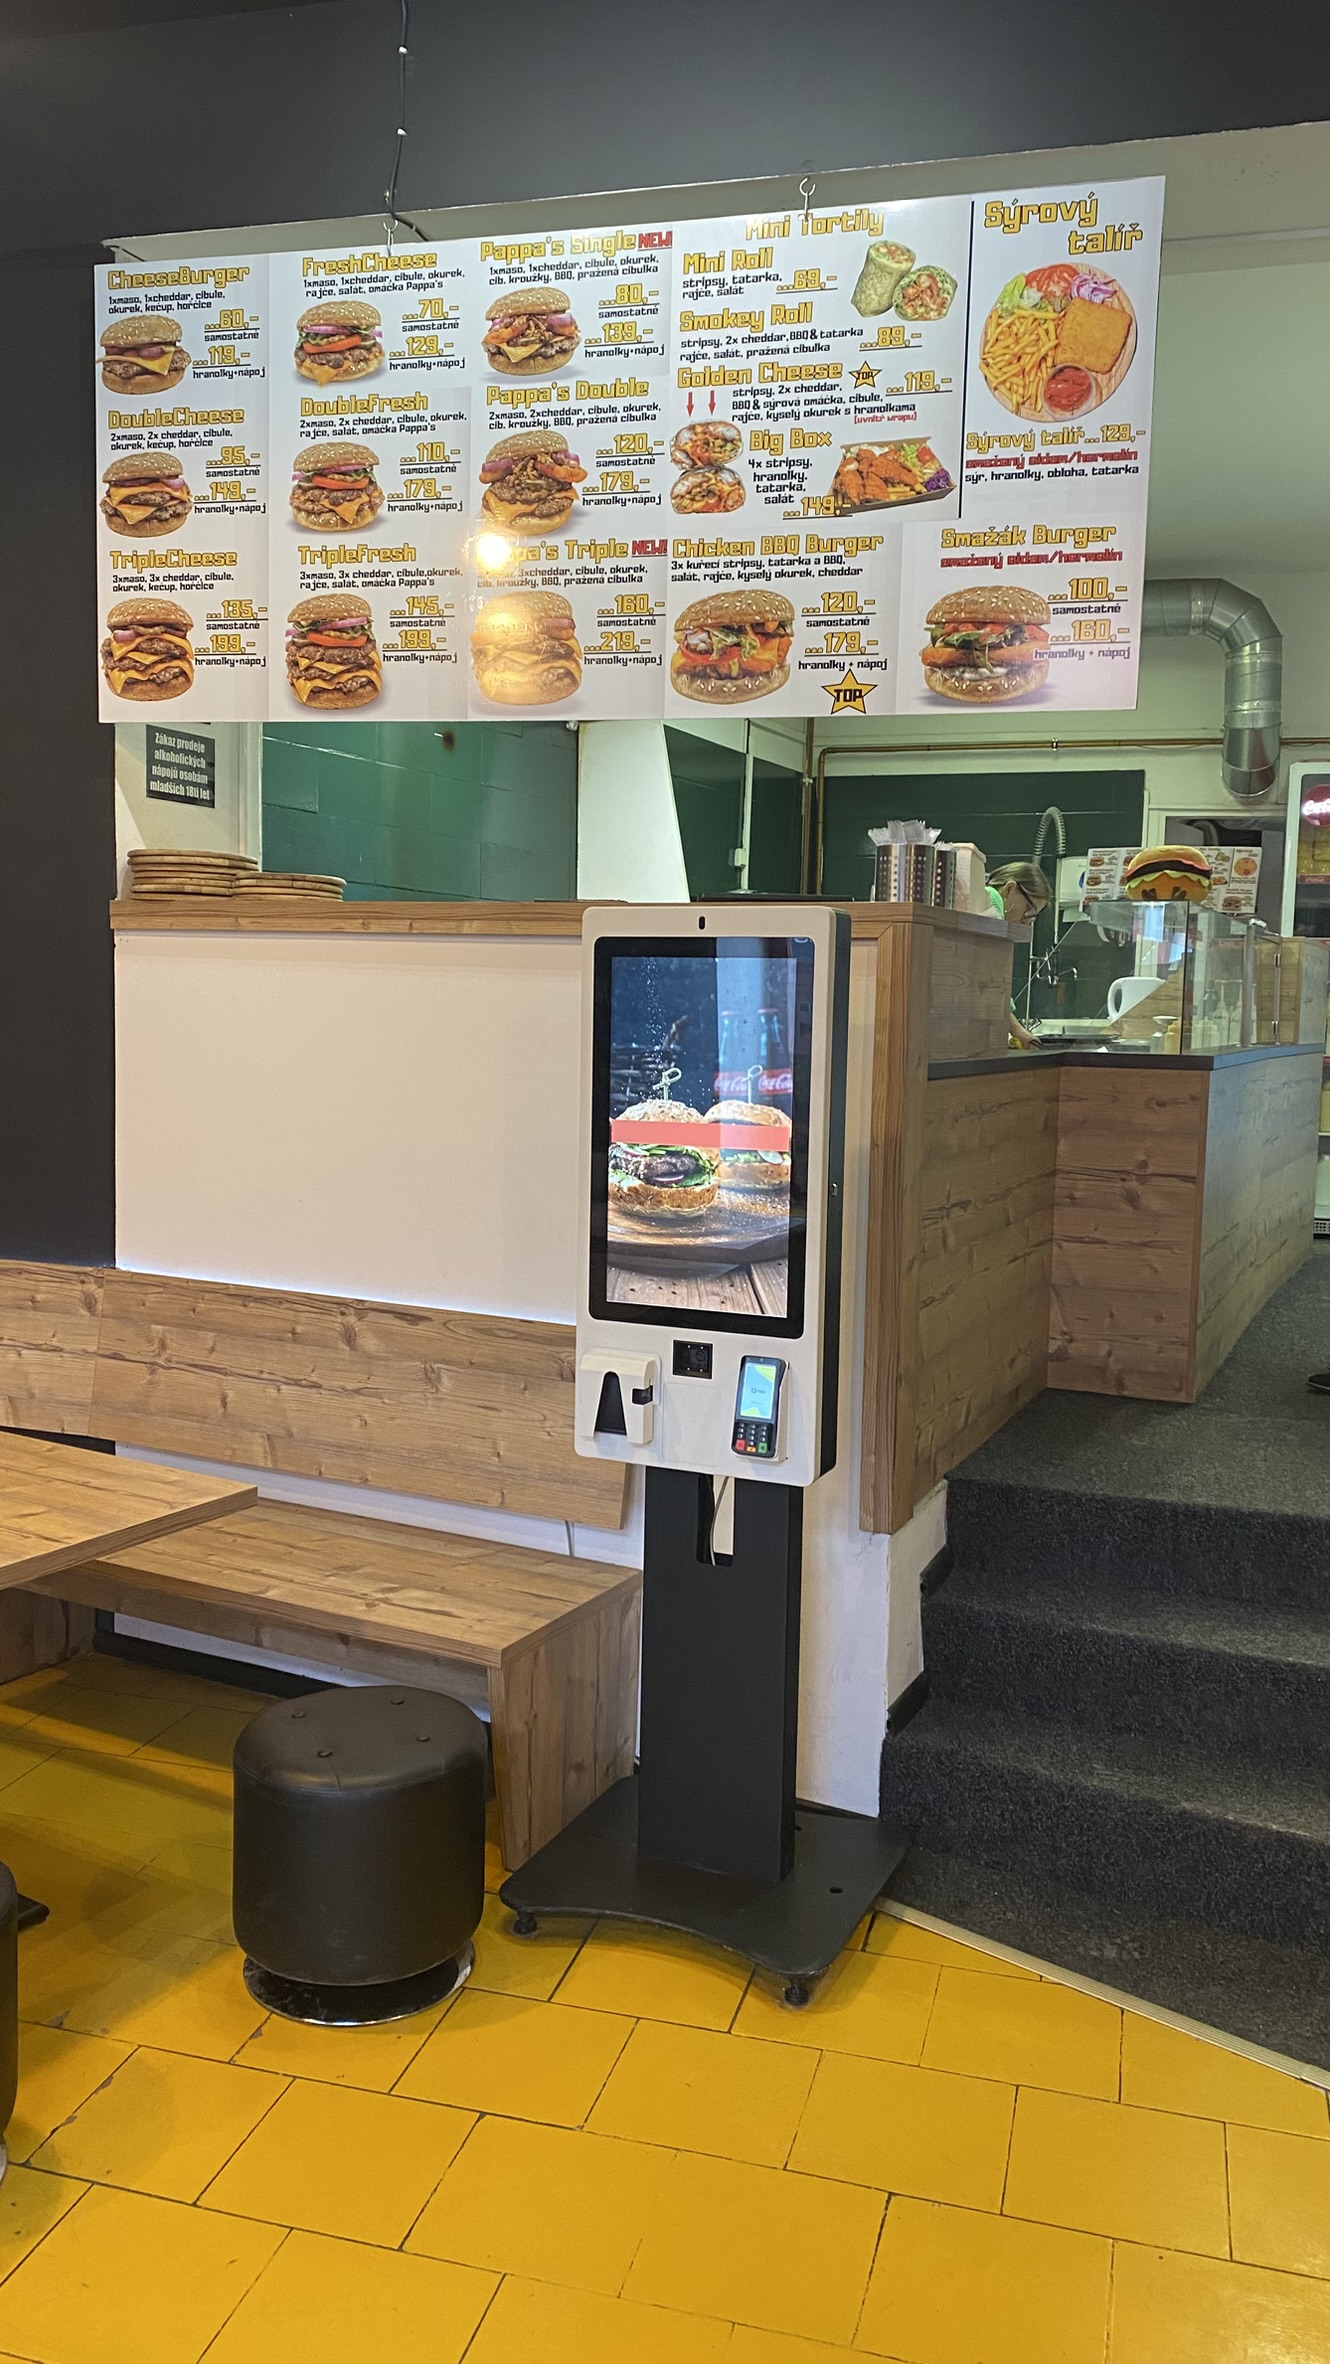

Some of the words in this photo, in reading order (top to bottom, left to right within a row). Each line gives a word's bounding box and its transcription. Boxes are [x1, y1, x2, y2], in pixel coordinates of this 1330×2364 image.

[984, 192, 1099, 234] Sýrový
[1068, 223, 1143, 255] talíř
[480, 236, 564, 265] Pappa's
[570, 230, 636, 257] Single
[302, 252, 437, 277] FreshCheese
[620, 254, 659, 265] okurek,
[684, 251, 725, 275] Mini
[731, 246, 773, 271] Roll
[108, 266, 249, 290] CheeseBurger
[428, 268, 465, 279] okurek,
[683, 275, 728, 289] stripsy,
[732, 272, 782, 285] tatarka,
[108, 305, 142, 314] okurek,
[679, 308, 764, 333] Smokey
[771, 302, 813, 324] Roll
[681, 336, 722, 349] stripsy,
[726, 335, 738, 345] 2x
[677, 364, 752, 389] Golden
[759, 362, 843, 382] Cheese
[487, 382, 570, 409] Pappa's
[576, 377, 649, 400] Double
[733, 385, 775, 398] stripsy,
[778, 385, 791, 394] 2x
[300, 391, 428, 417] DoubleFresh
[623, 402, 661, 412] okurek,
[803, 407, 842, 417] okurek
[108, 407, 244, 429] DoubleCheese
[339, 418, 350, 426] 2x
[430, 412, 467, 421] okurek,
[111, 442, 144, 450] okurek,
[749, 430, 783, 456] Big
[790, 428, 832, 448] Box
[965, 429, 1035, 454] Sýrový
[748, 459, 763, 468] 4x
[766, 457, 812, 470] stripsy,
[753, 471, 807, 483] hranolky,
[991, 468, 1043, 481] hranolky,
[1047, 466, 1088, 478] obloha,
[1092, 465, 1139, 476] tatarka
[756, 482, 806, 493] tatarka,
[941, 525, 1026, 548] Smažák
[1033, 524, 1116, 548] Burger
[565, 539, 628, 563] Triple
[672, 538, 755, 558] Chicken
[760, 535, 800, 556] BBQ
[805, 534, 883, 558] Burger
[110, 549, 237, 573] TripleCheese
[298, 543, 416, 569] TripleFresh
[671, 561, 683, 570] 3x
[723, 559, 765, 570] stripsy,
[768, 557, 811, 567] tatarka
[610, 564, 648, 574] okurek,
[774, 568, 815, 579] okurek,
[818, 567, 863, 577] cheddar
[150, 574, 160, 582] 3x
[113, 584, 146, 592] okurek,
[1034, 648, 1085, 660] hranolky
[798, 660, 845, 671] hranolky
[857, 658, 888, 670] nápoj
[834, 689, 862, 702] TOP
[155, 732, 175, 747] Zákaz
[177, 739, 205, 753] prodeje
[155, 749, 206, 768] alkoholických
[180, 770, 208, 784] osobám
[150, 780, 185, 795] mladších
[200, 788, 210, 800] let
